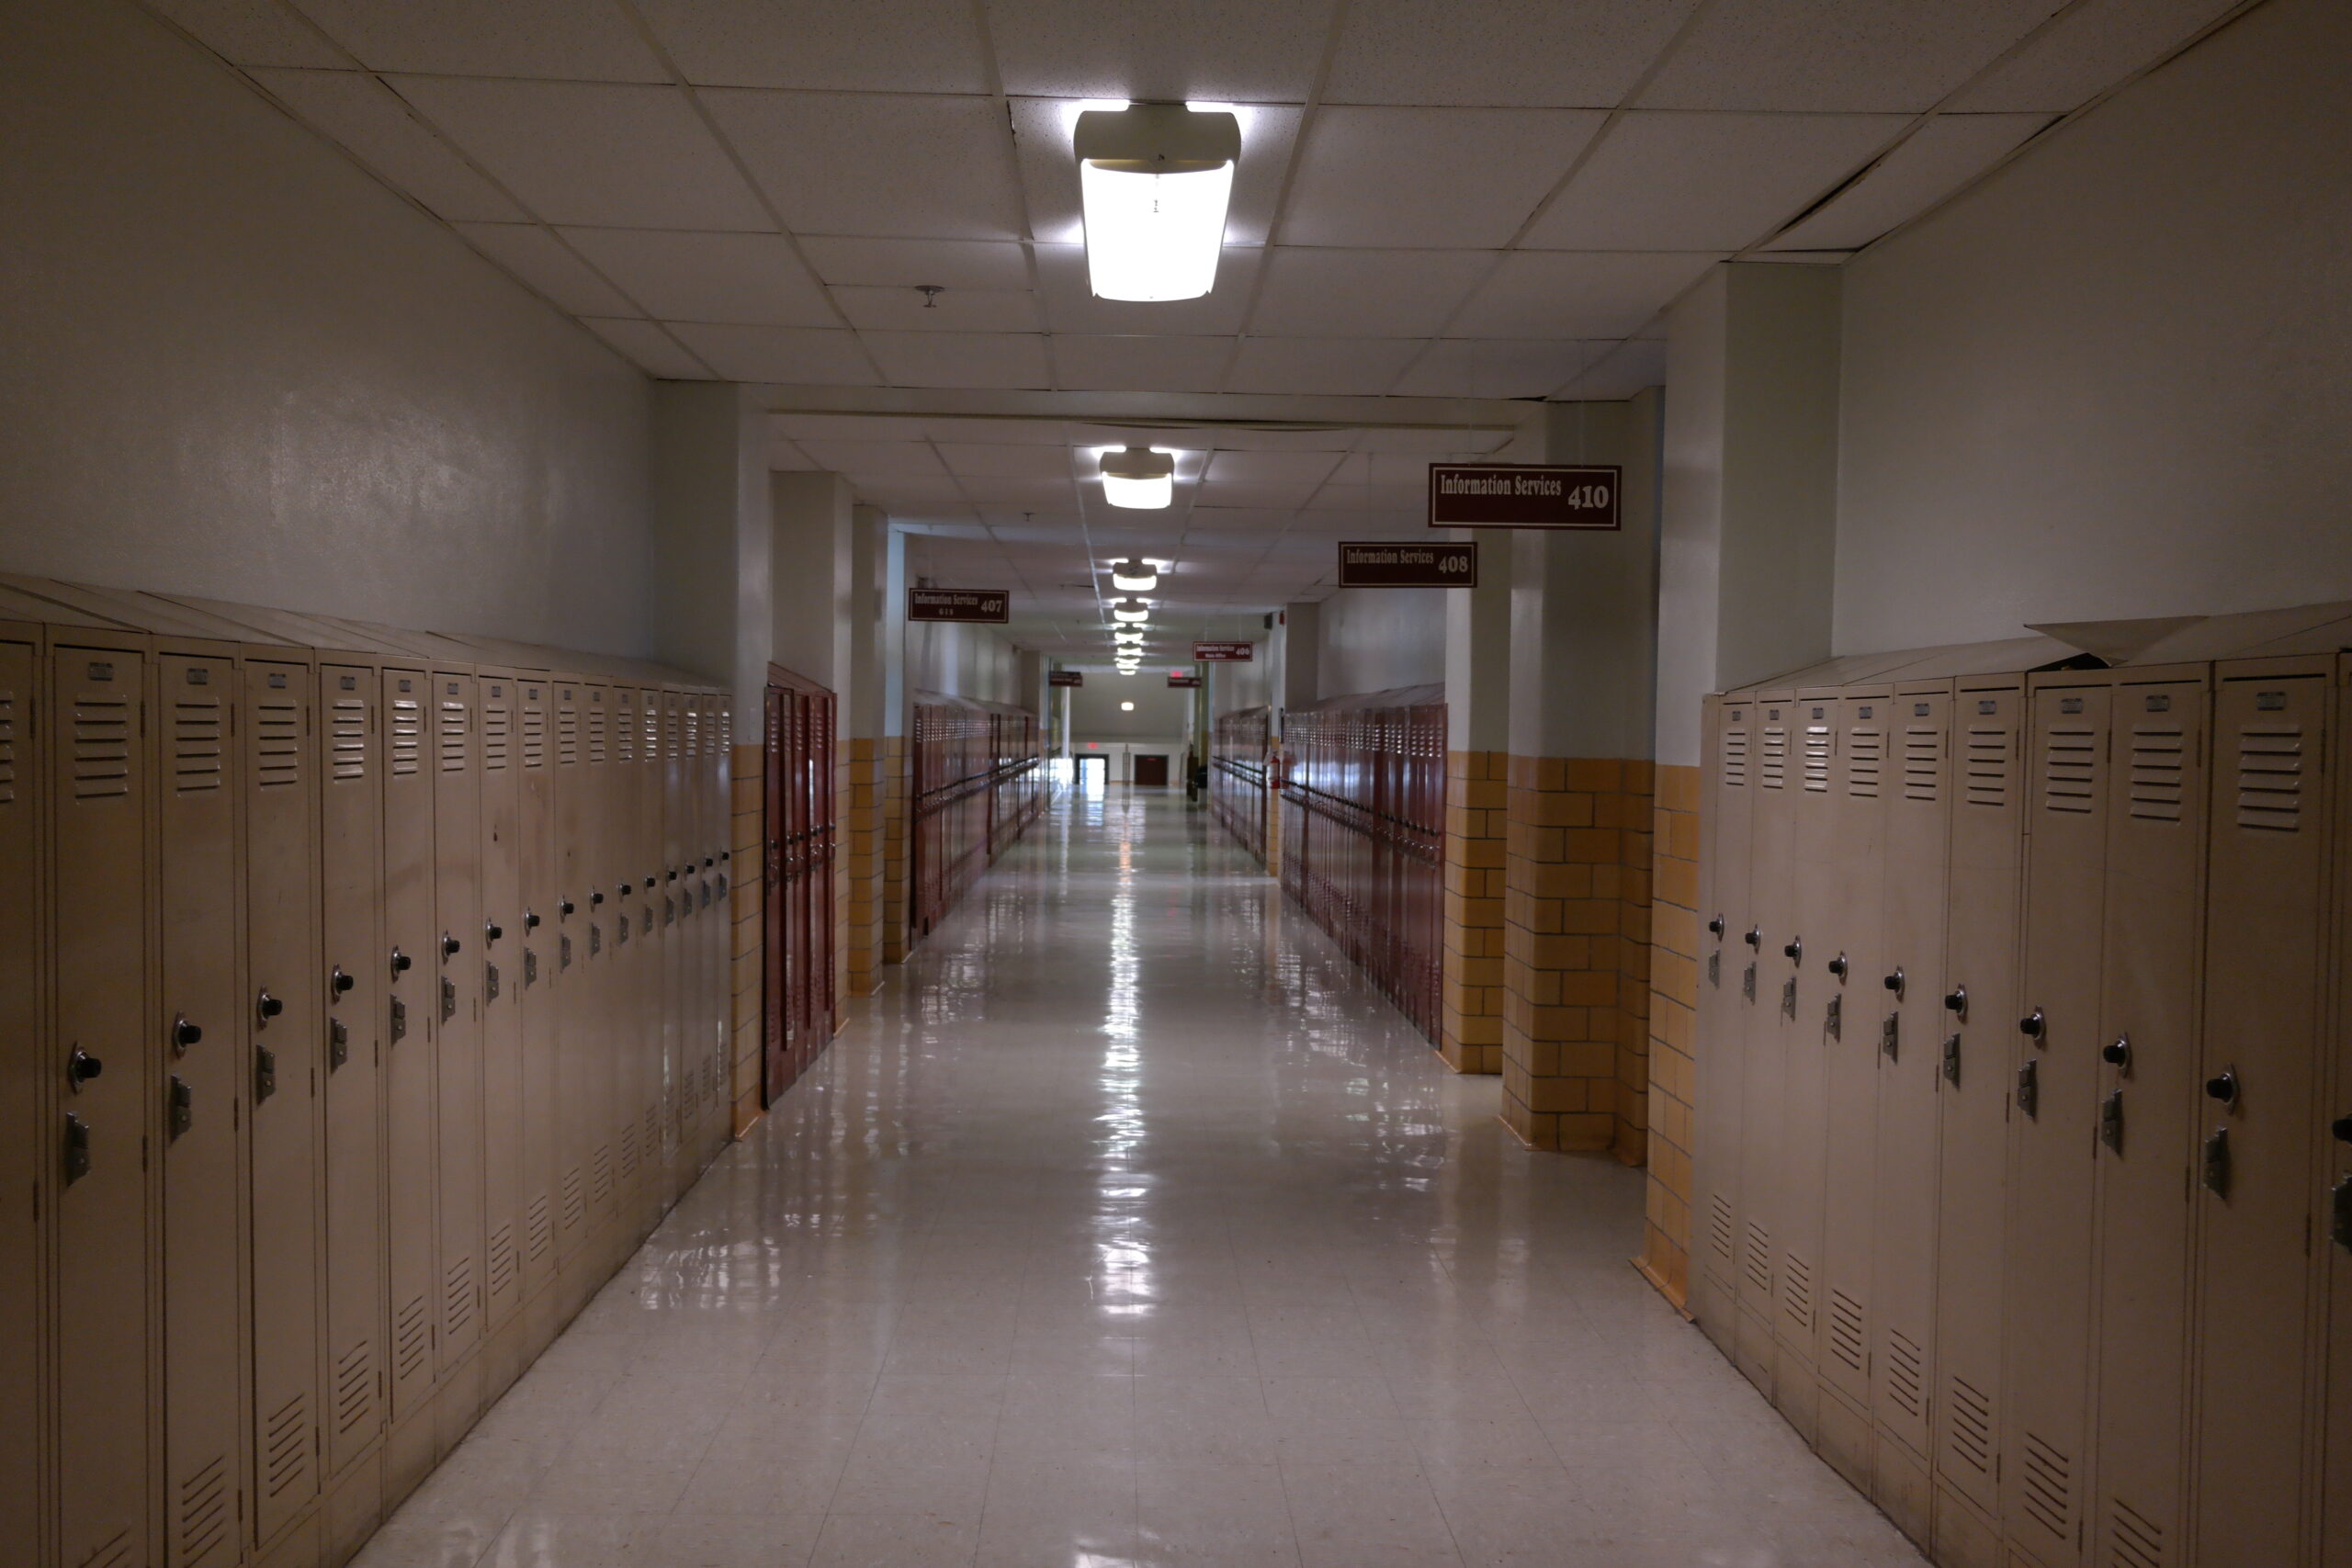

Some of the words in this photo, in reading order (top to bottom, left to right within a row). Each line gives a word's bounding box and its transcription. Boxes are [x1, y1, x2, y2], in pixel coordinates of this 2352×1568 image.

[1441, 474, 1511, 495] Information
[1515, 475, 1562, 497] Services
[1567, 485, 1609, 511] 410
[1347, 548, 1397, 564] Information
[1400, 549, 1434, 564] Services
[1438, 556, 1469, 573] 408
[914, 592, 952, 605] Information
[953, 594, 978, 606] Services
[980, 600, 1002, 613] 407
